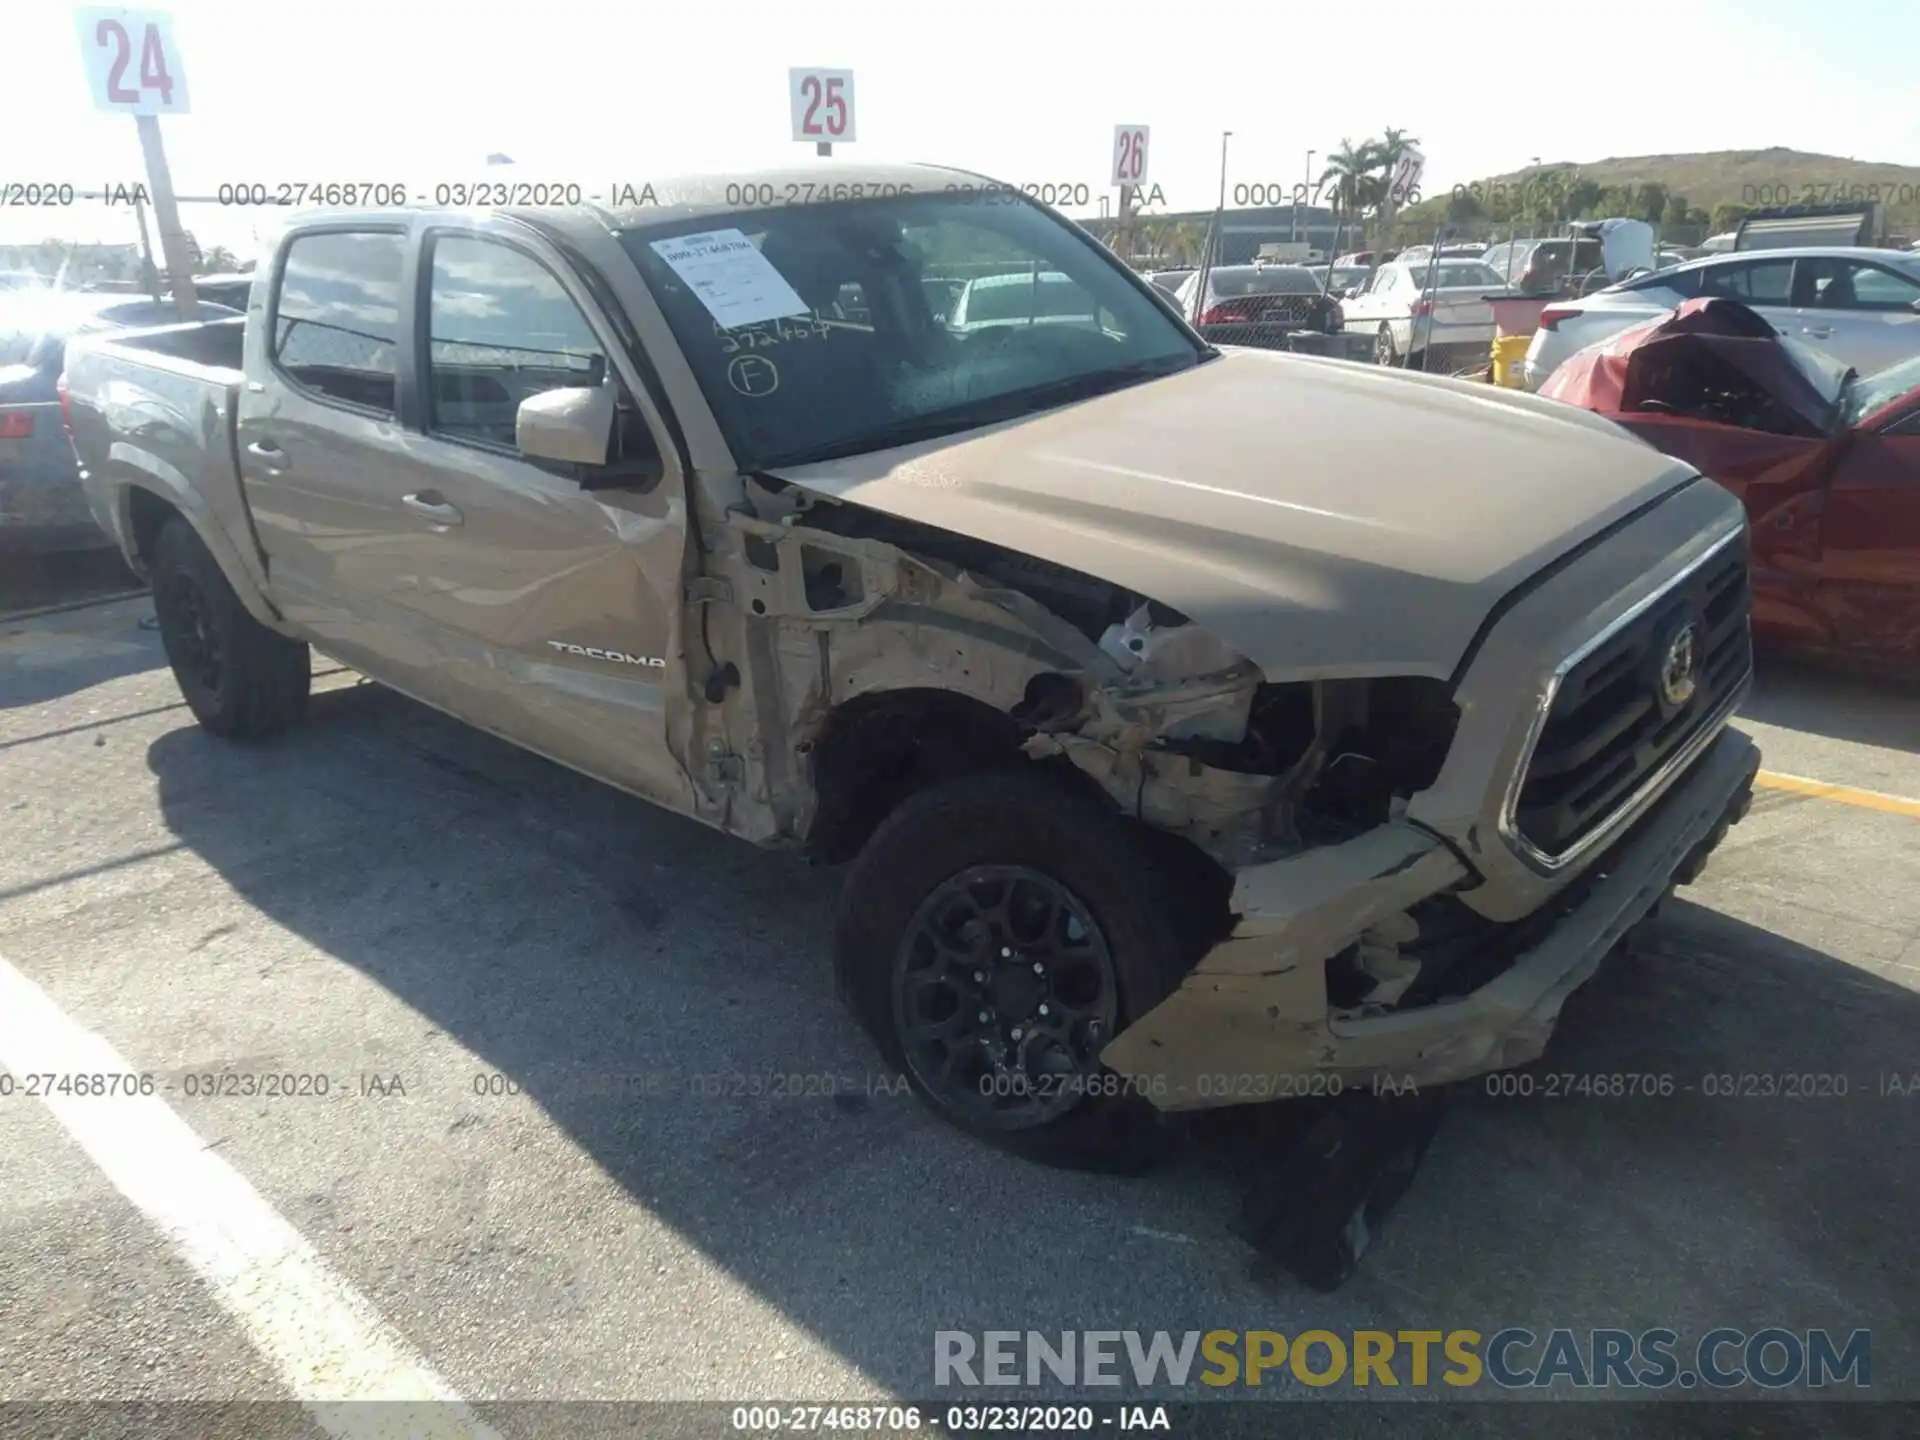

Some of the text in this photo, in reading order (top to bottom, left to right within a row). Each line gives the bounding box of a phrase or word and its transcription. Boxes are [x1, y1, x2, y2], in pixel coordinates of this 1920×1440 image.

[96, 18, 173, 105] 24
[800, 74, 847, 136] 25
[1117, 130, 1144, 180] 26
[1393, 157, 1422, 193] 27
[548, 640, 666, 668] TACOMA
